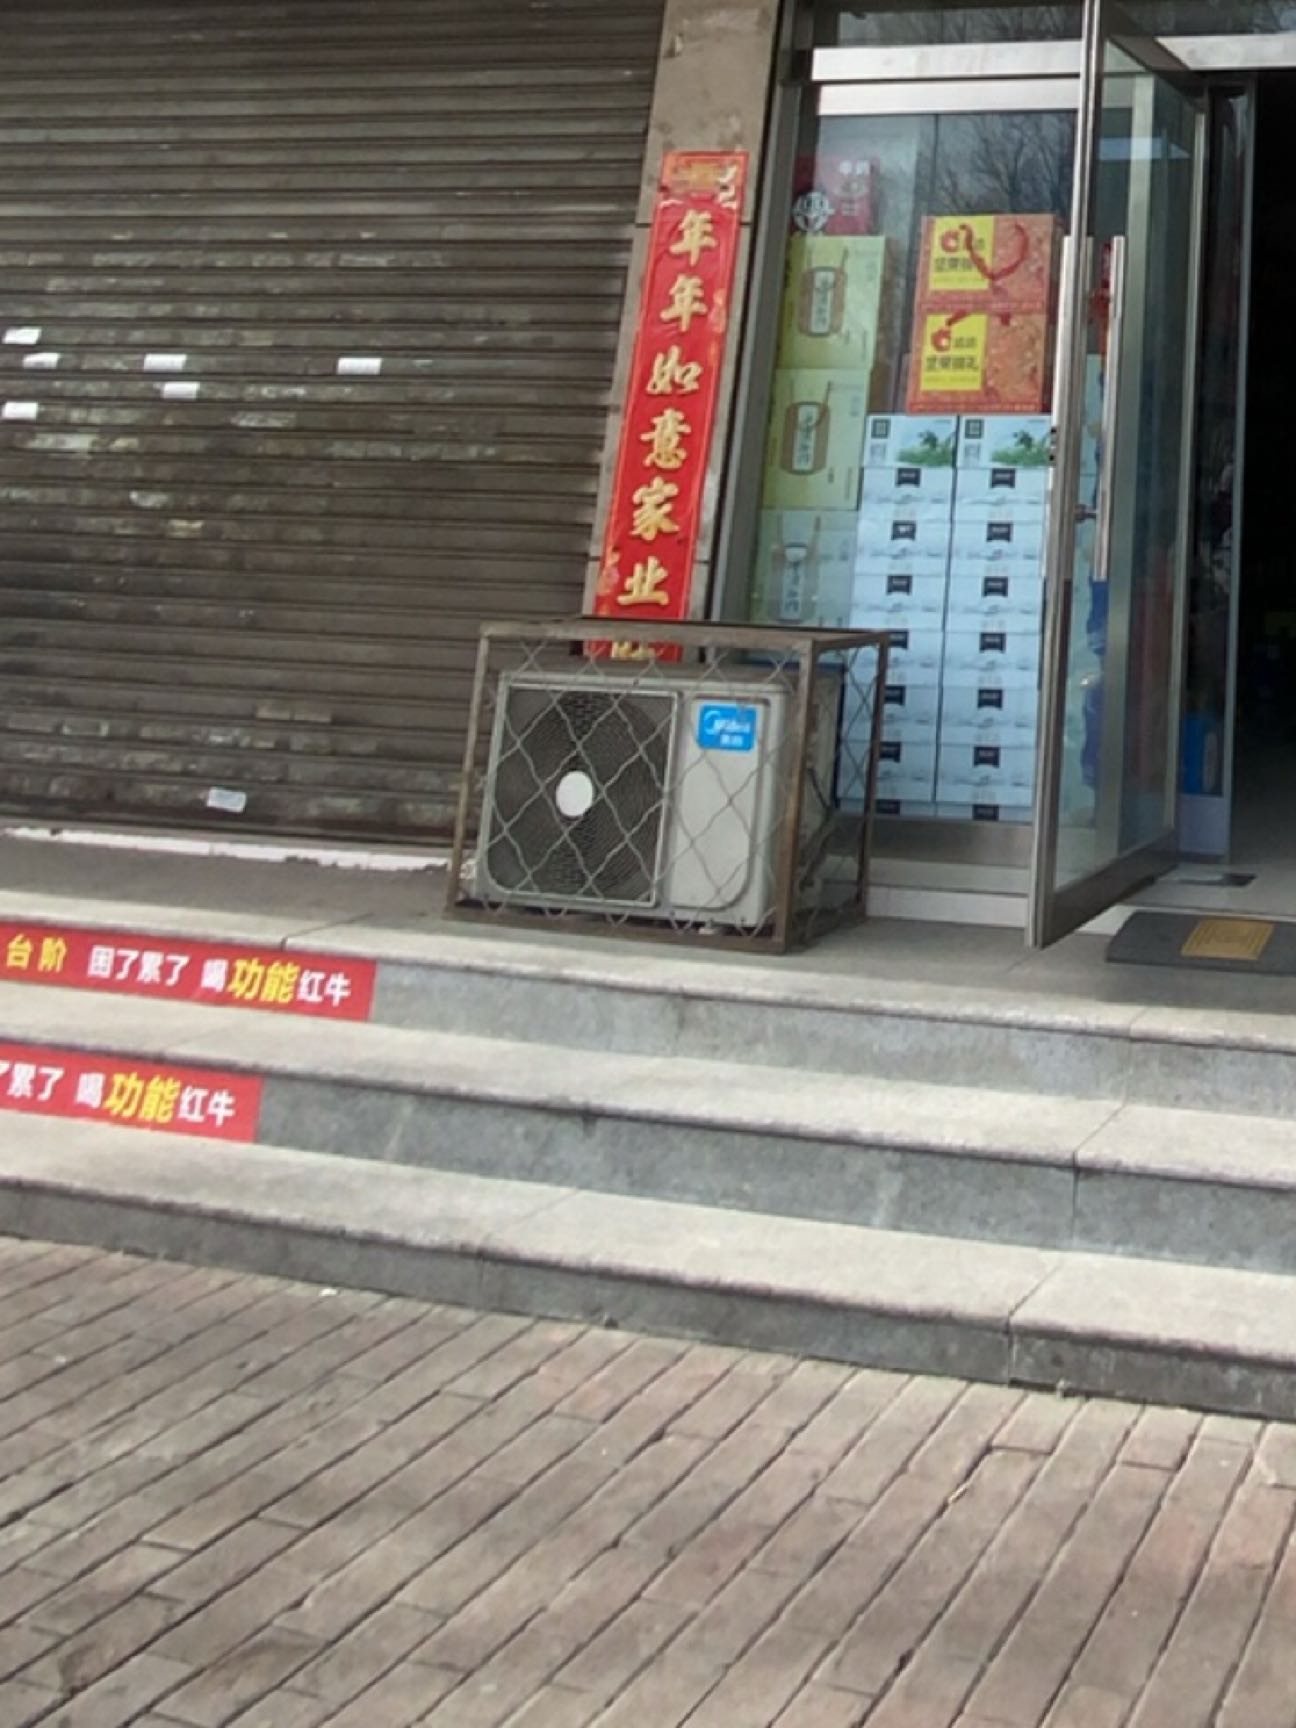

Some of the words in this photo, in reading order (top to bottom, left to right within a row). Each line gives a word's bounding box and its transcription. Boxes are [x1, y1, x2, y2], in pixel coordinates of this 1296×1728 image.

[6, 934, 68, 974] 台阶
[199, 956, 352, 1007] 喝功能红牛
[74, 1071, 237, 1128] 喝功能红牛
